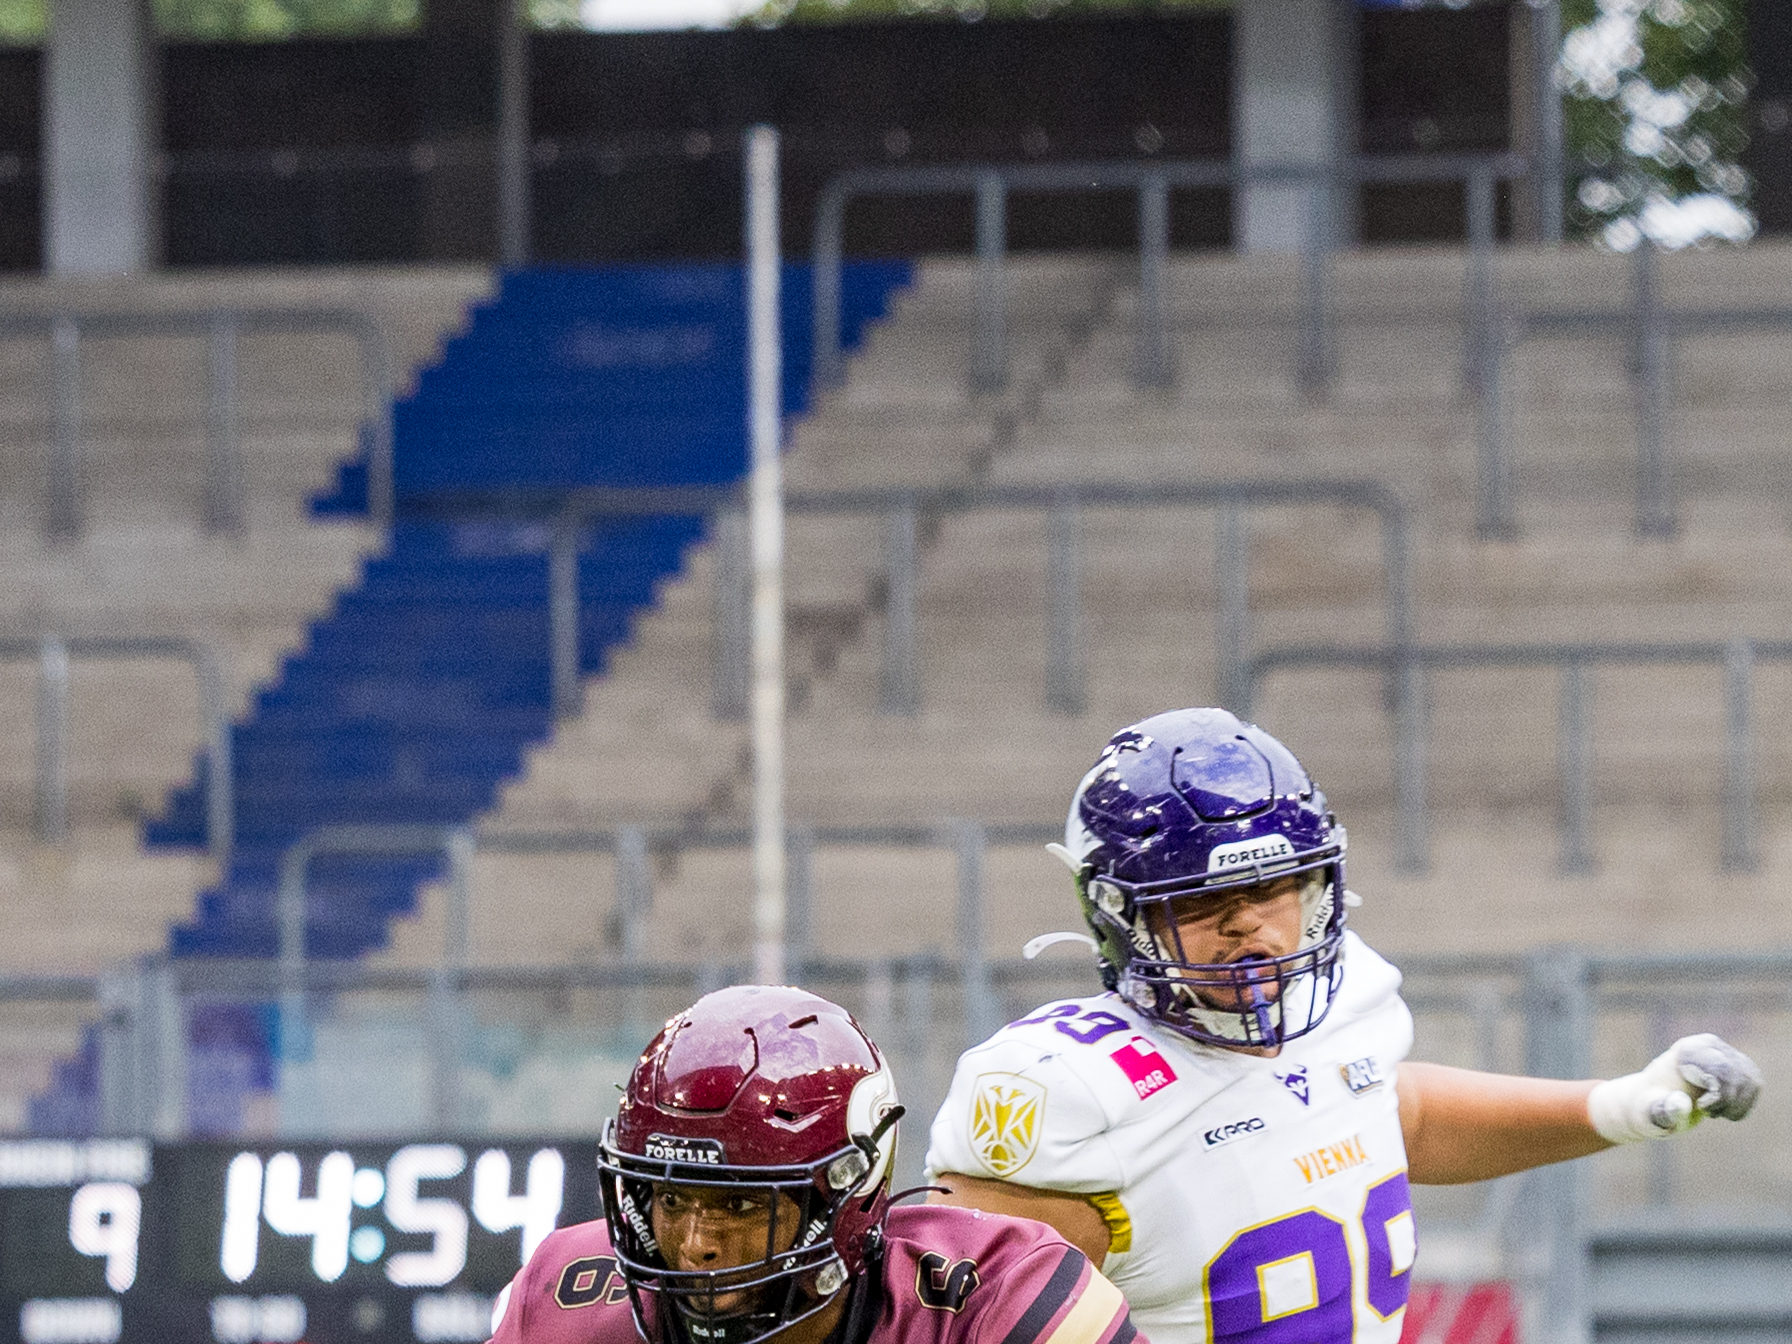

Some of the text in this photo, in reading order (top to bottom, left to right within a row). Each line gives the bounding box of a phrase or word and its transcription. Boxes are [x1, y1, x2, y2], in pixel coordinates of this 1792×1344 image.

[1218, 843, 1287, 866] FORELLE
[1134, 1070, 1168, 1096] R4R
[645, 1144, 720, 1164] FORELLE
[1293, 1134, 1371, 1183] VIENNA
[221, 1144, 565, 1287] 14:54
[69, 1182, 142, 1293] 9
